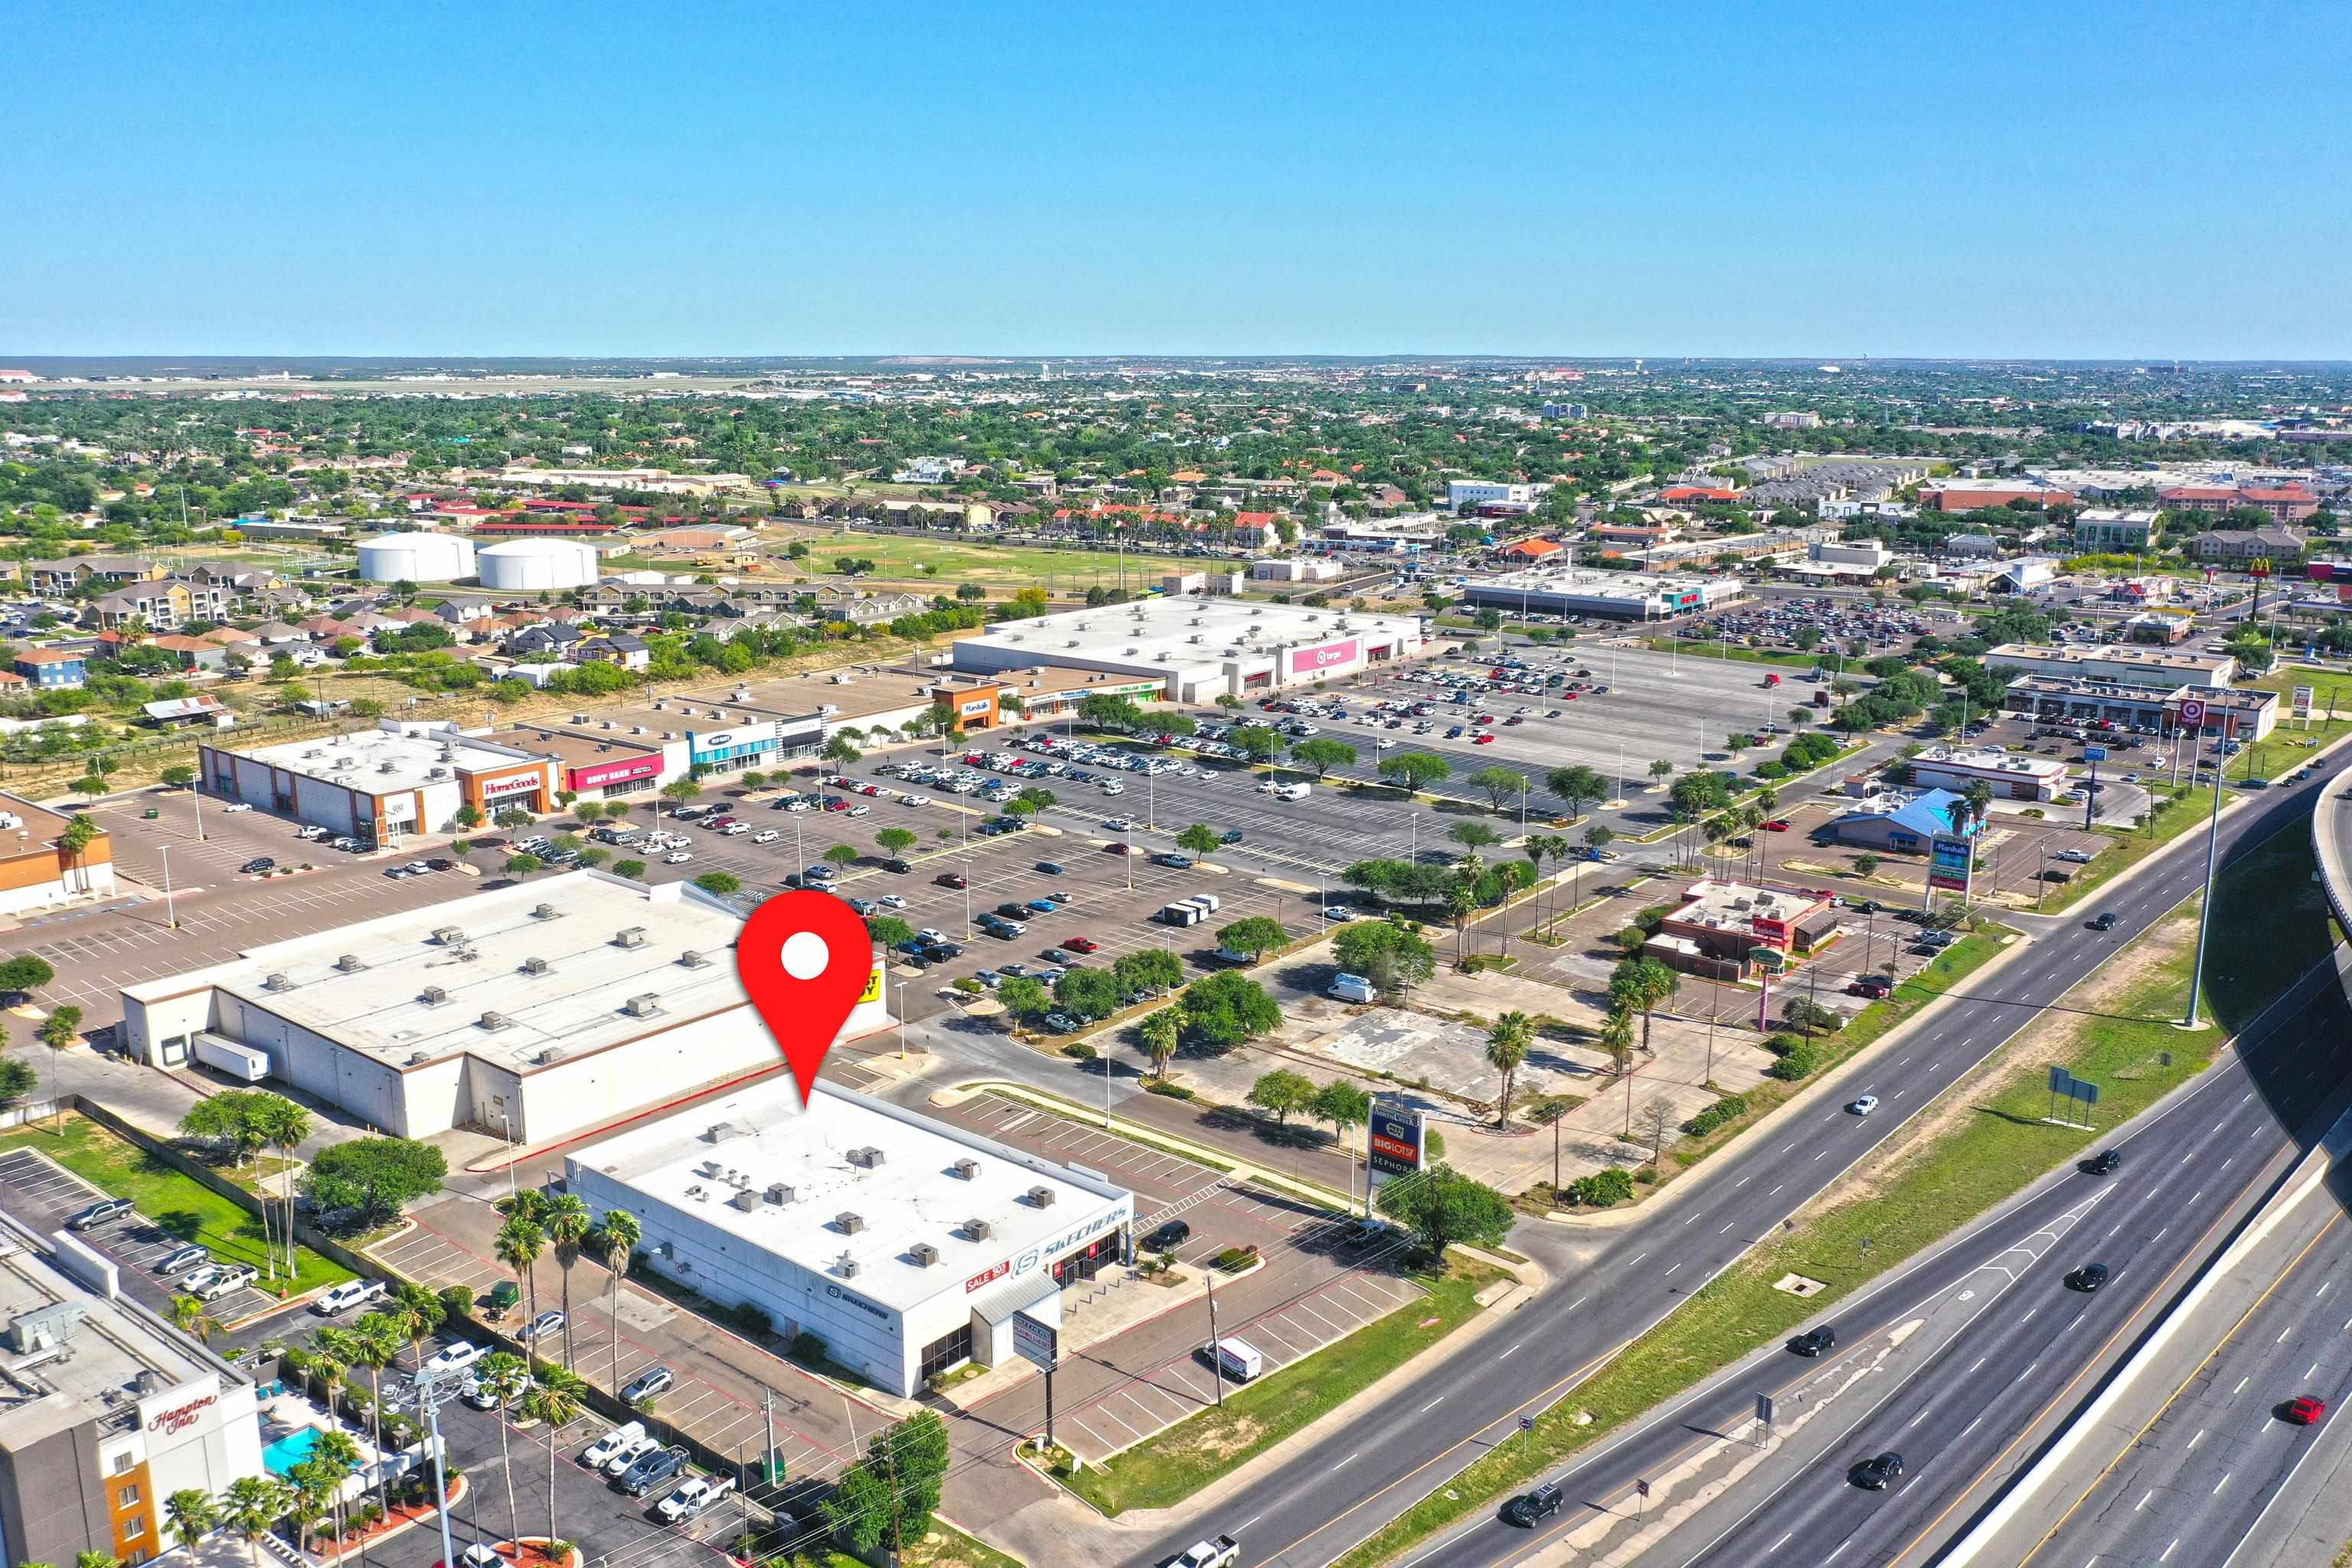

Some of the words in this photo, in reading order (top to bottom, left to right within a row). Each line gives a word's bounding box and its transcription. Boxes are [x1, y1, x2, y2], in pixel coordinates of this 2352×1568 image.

[1326, 651, 1341, 661] target
[966, 702, 988, 711] Marshalls
[485, 776, 538, 795] HomeGoods
[586, 773, 607, 785] BOOT
[1936, 844, 1967, 854] Marshalls
[1044, 1207, 1127, 1255] SKECHERS
[967, 1272, 990, 1291] SALE
[149, 1395, 217, 1432] Hampton
[166, 1414, 199, 1435] Inn
